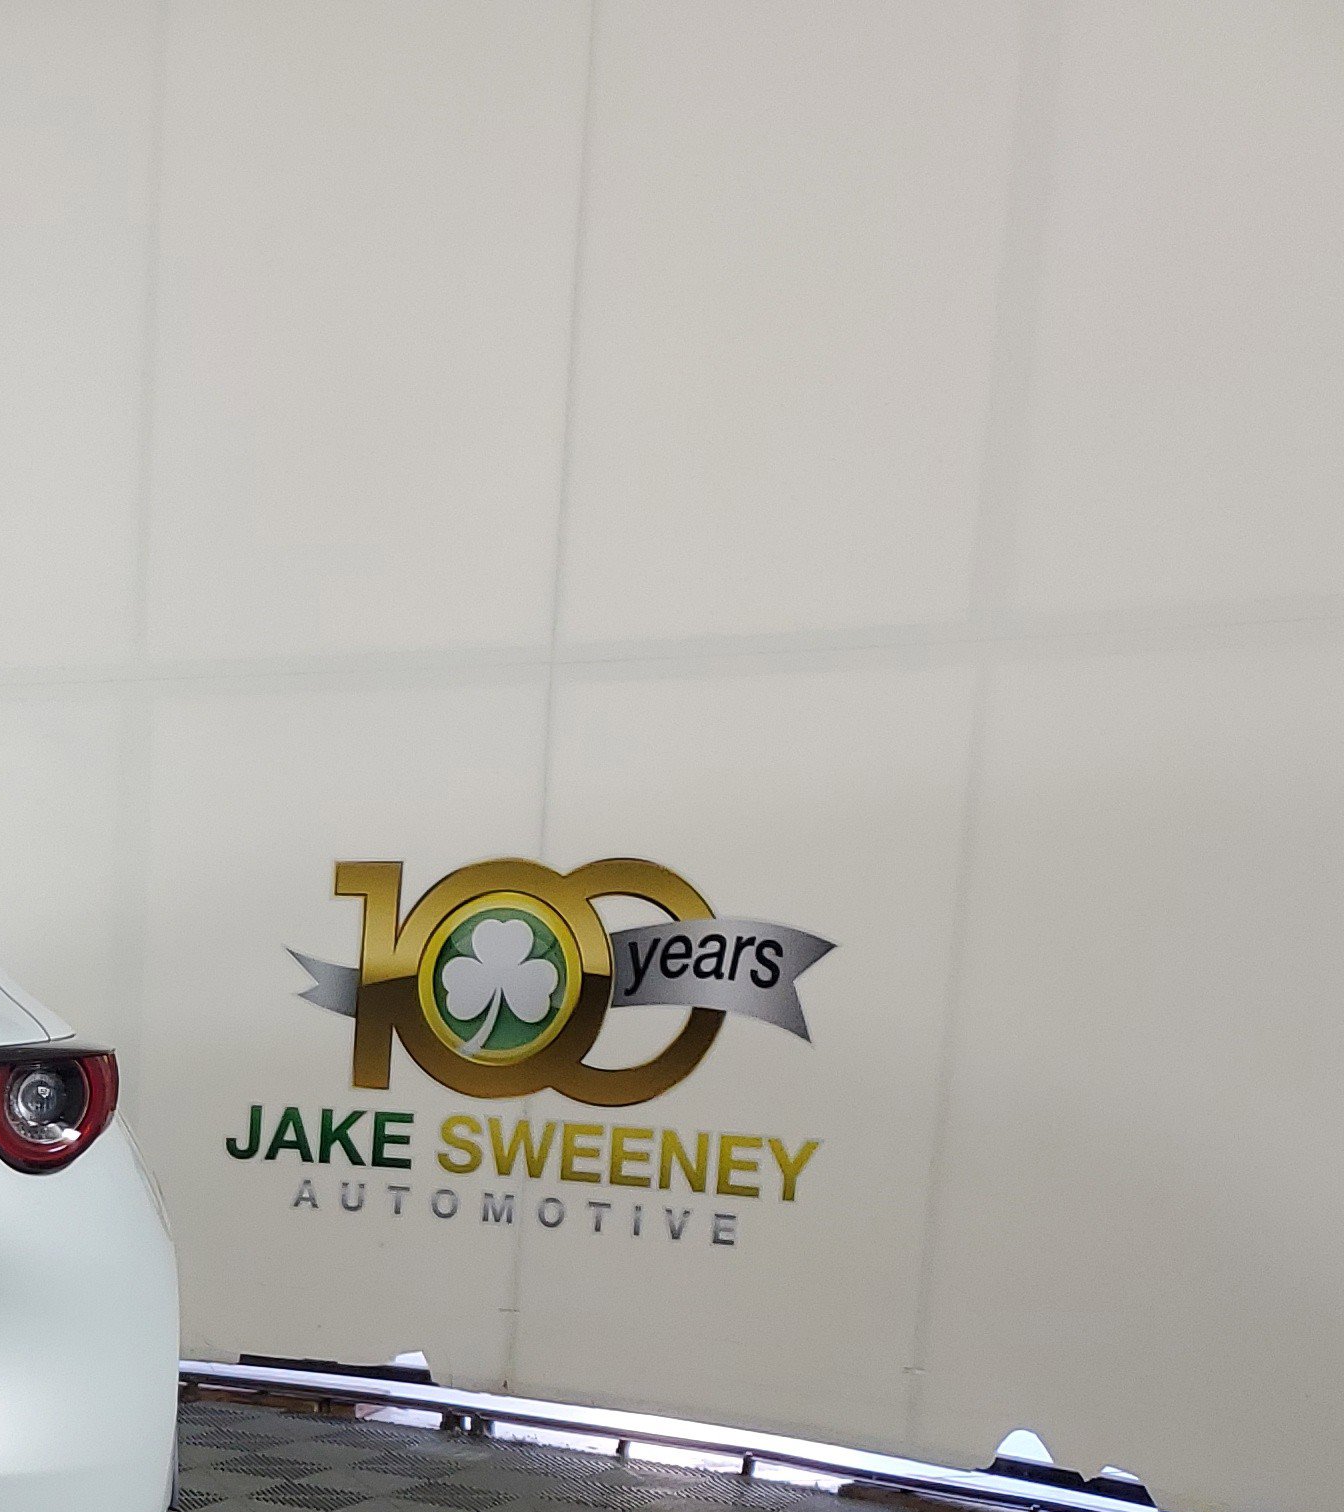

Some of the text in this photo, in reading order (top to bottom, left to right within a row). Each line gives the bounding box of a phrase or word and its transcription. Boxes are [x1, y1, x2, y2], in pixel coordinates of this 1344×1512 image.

[622, 931, 785, 996] years
[225, 1103, 821, 1202] JAKE SWEENEY
[293, 1179, 739, 1246] AUTOMOTIVE
